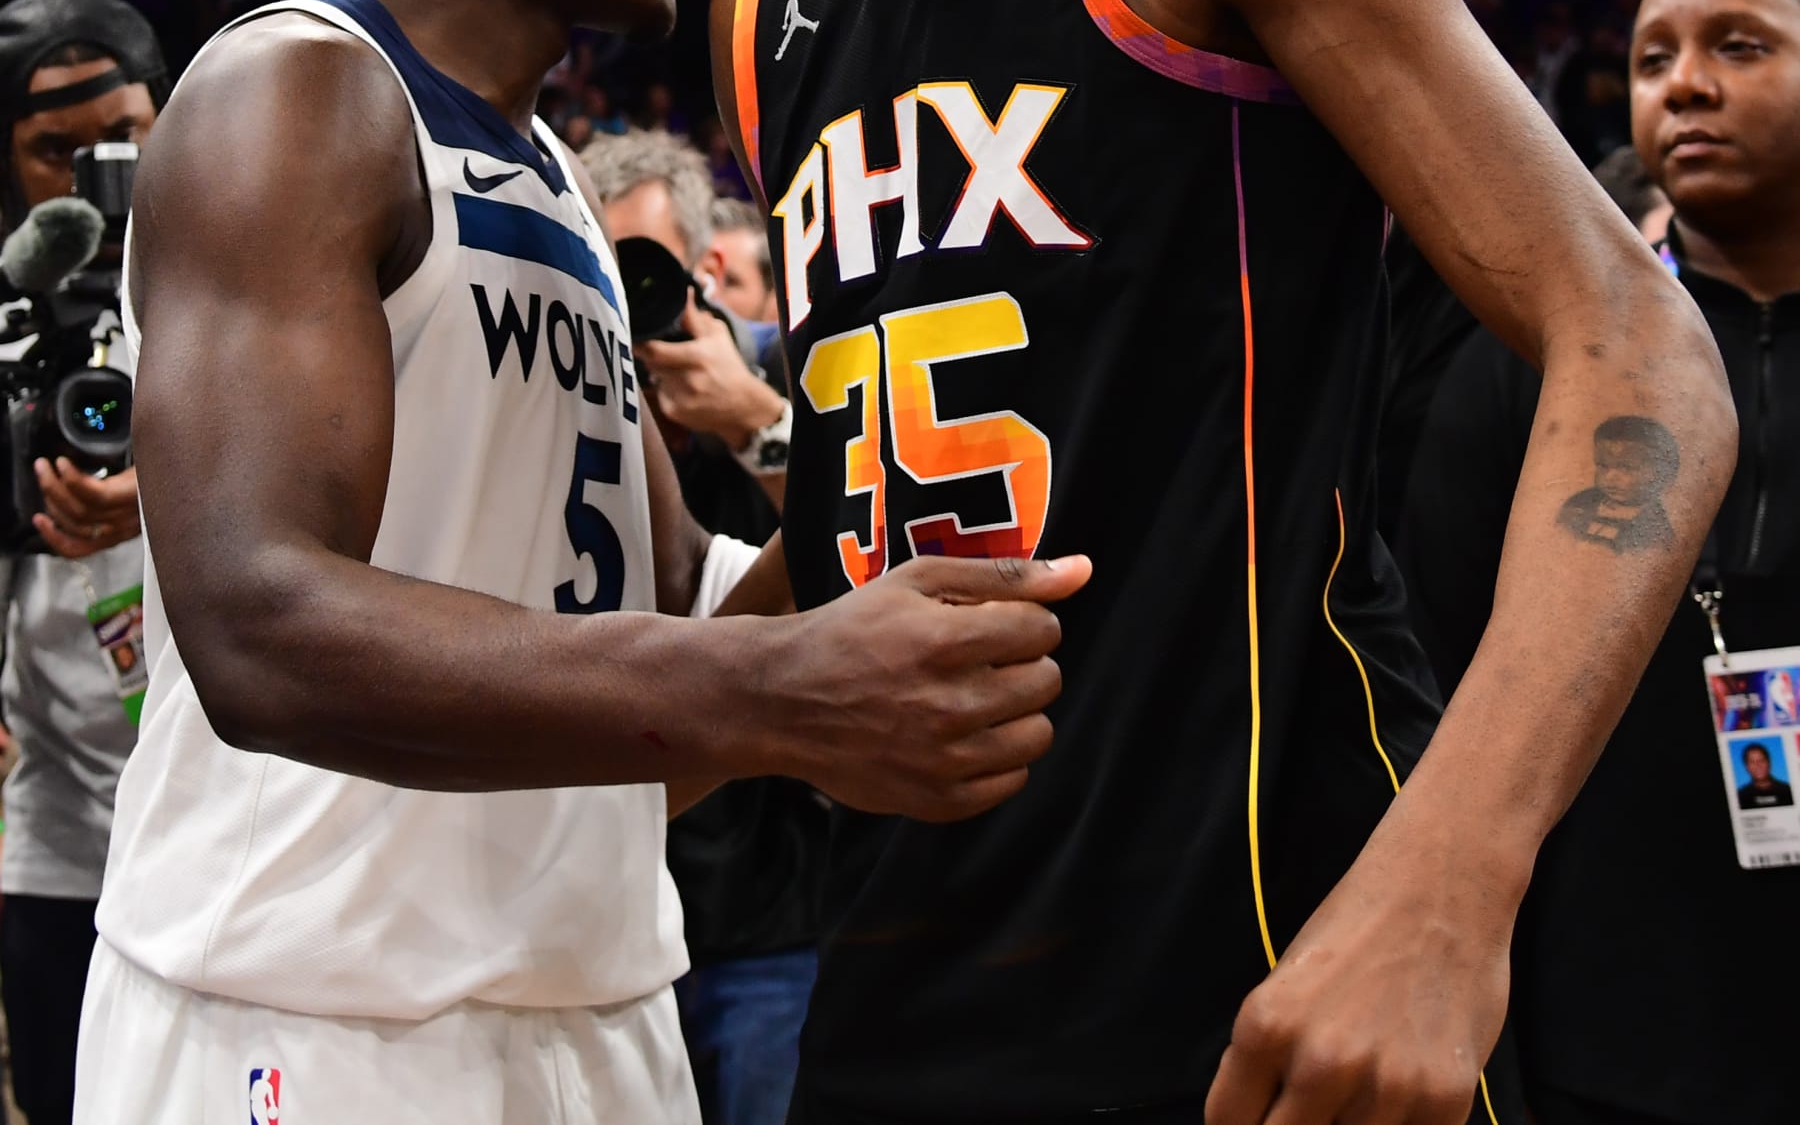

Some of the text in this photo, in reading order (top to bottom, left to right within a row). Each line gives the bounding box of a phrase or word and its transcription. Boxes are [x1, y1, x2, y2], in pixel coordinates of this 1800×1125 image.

[772, 81, 1093, 333] PHX
[553, 431, 625, 614] 5
[800, 291, 1053, 589] 35
